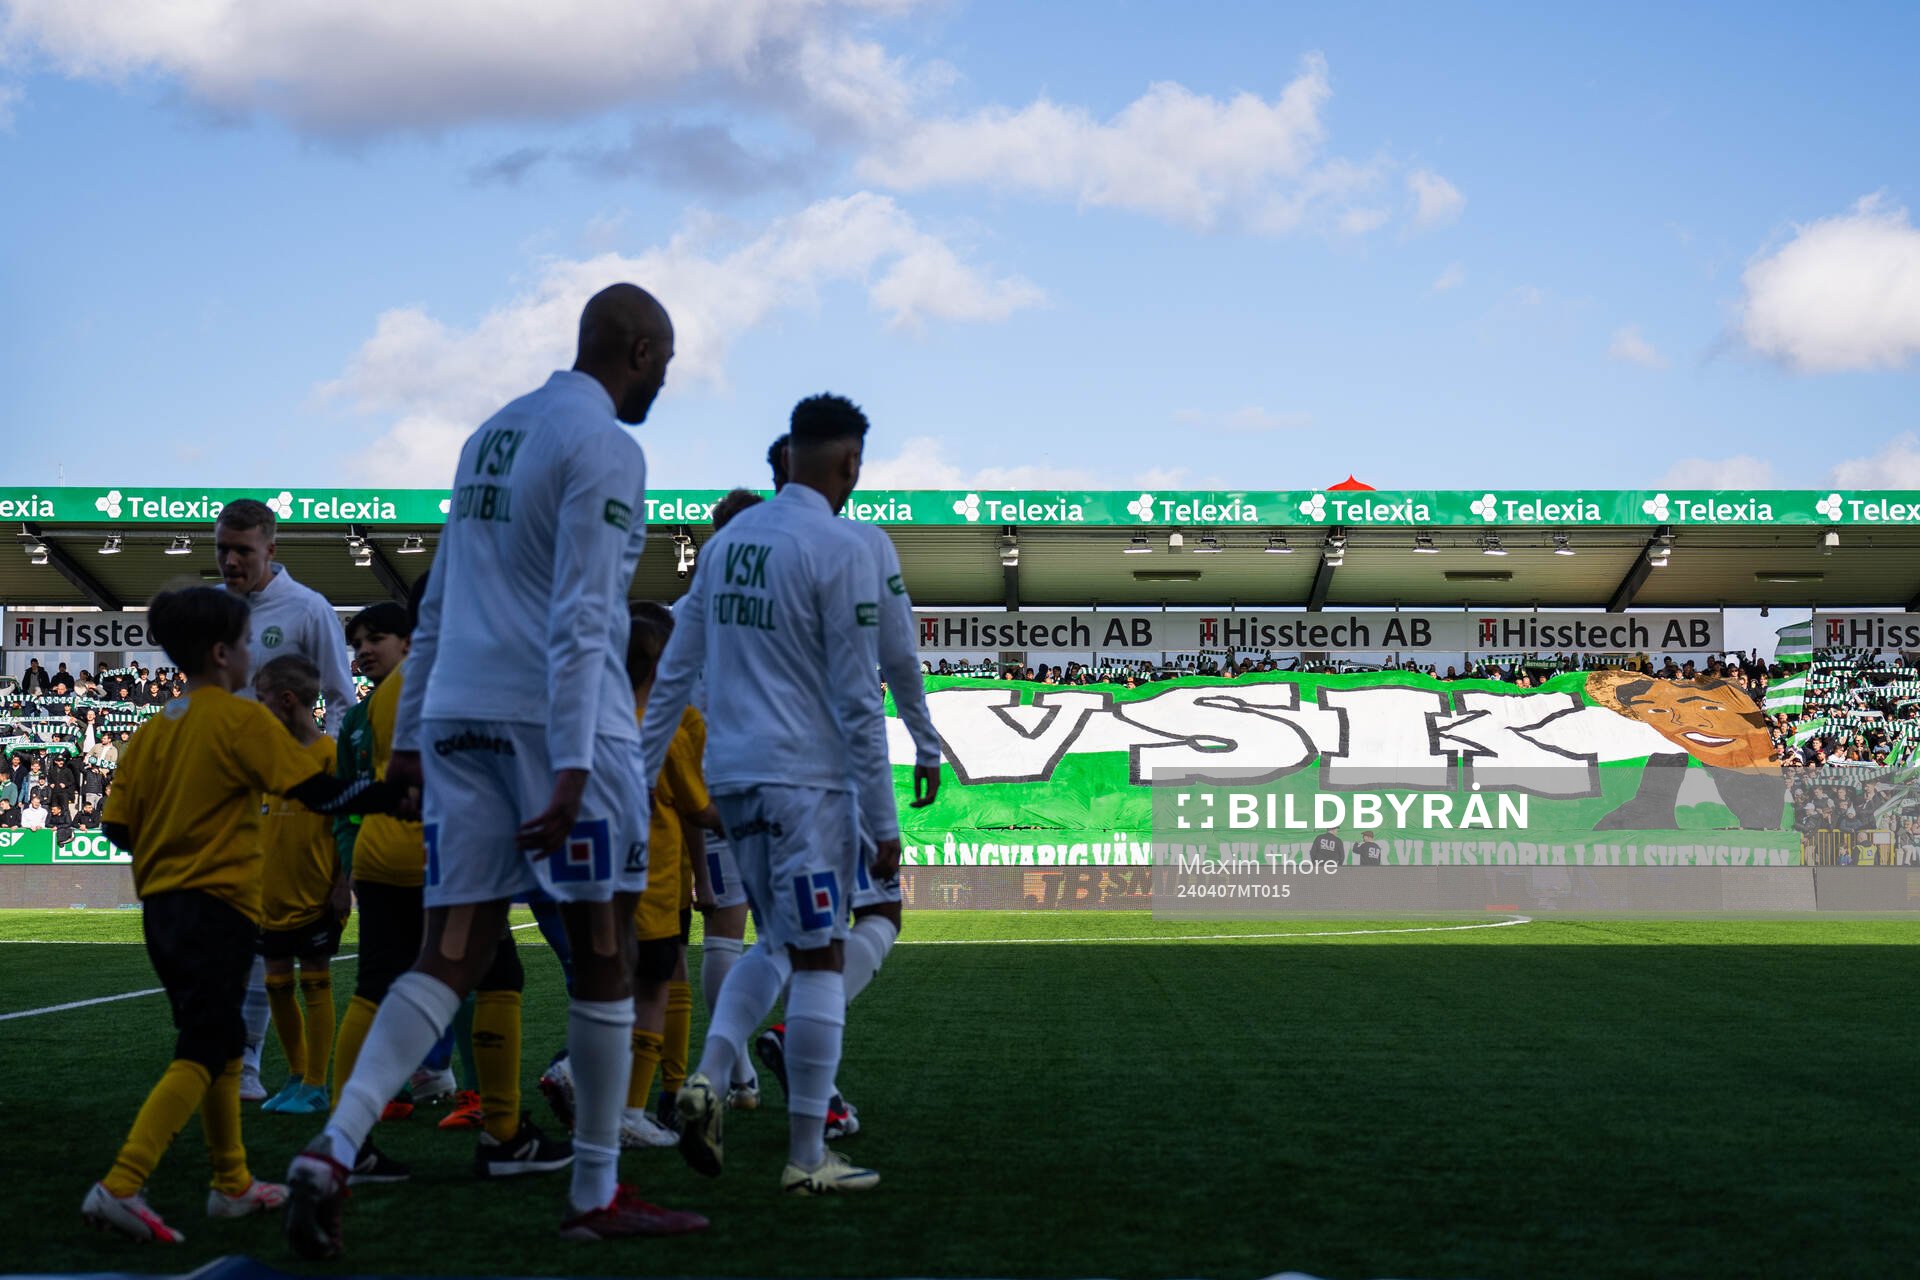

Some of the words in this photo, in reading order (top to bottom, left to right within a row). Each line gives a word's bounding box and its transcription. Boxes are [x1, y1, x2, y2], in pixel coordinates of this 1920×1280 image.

[475, 429, 527, 476] VSK
[127, 496, 224, 519] Telexia
[298, 497, 397, 520] Telexia
[644, 498, 723, 521] Telex
[838, 499, 913, 521] lexia
[985, 498, 1084, 521] Telexia
[1160, 498, 1258, 522] Telexia
[1332, 498, 1430, 522] Telexia
[1502, 498, 1601, 522] Telexia
[1675, 498, 1774, 522] Telexia
[725, 542, 772, 588] VSK
[944, 616, 1091, 648] Hisstech
[1102, 618, 1152, 647] AB
[1223, 616, 1370, 648] Hisstech
[1382, 618, 1432, 647] AB
[1503, 617, 1649, 649] Hisstech
[1661, 618, 1711, 648] AB
[897, 682, 1602, 800] VSK
[1394, 839, 1424, 866] VI
